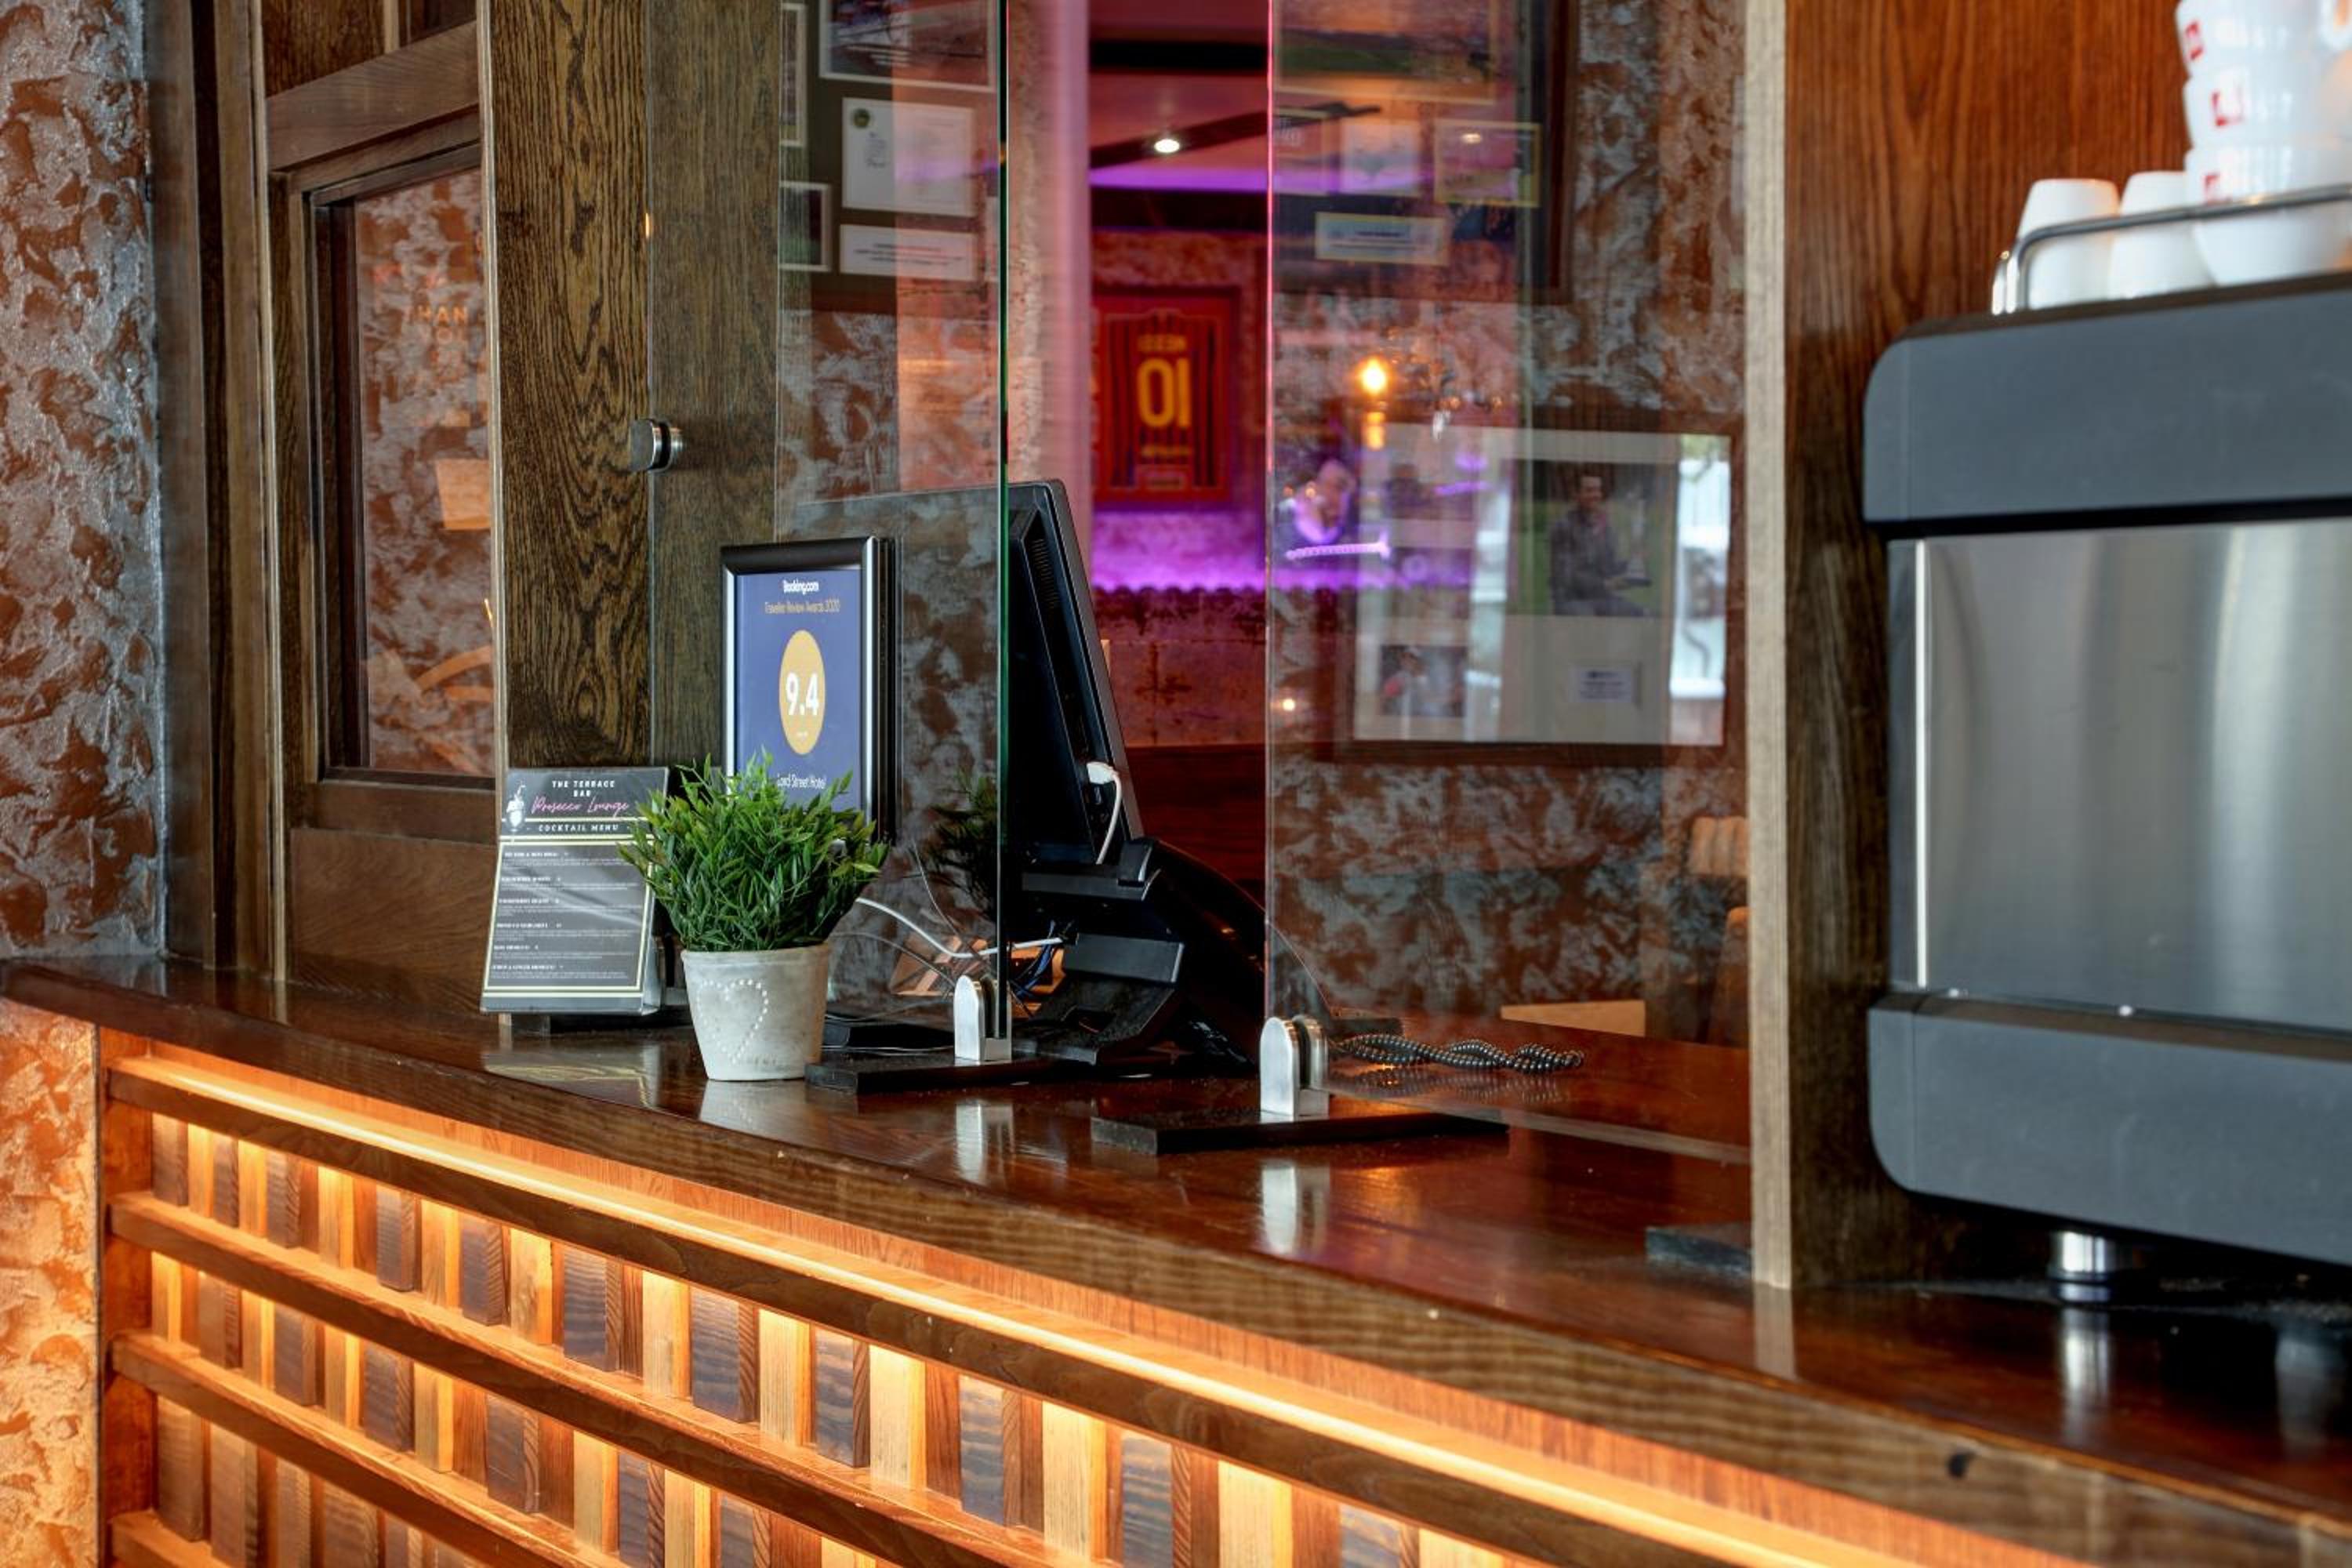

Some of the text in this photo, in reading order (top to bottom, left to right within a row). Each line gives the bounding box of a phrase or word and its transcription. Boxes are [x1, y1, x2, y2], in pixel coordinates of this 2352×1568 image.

[785, 671, 820, 717] 9.4
[531, 794, 630, 819] Prosecco Lounge
